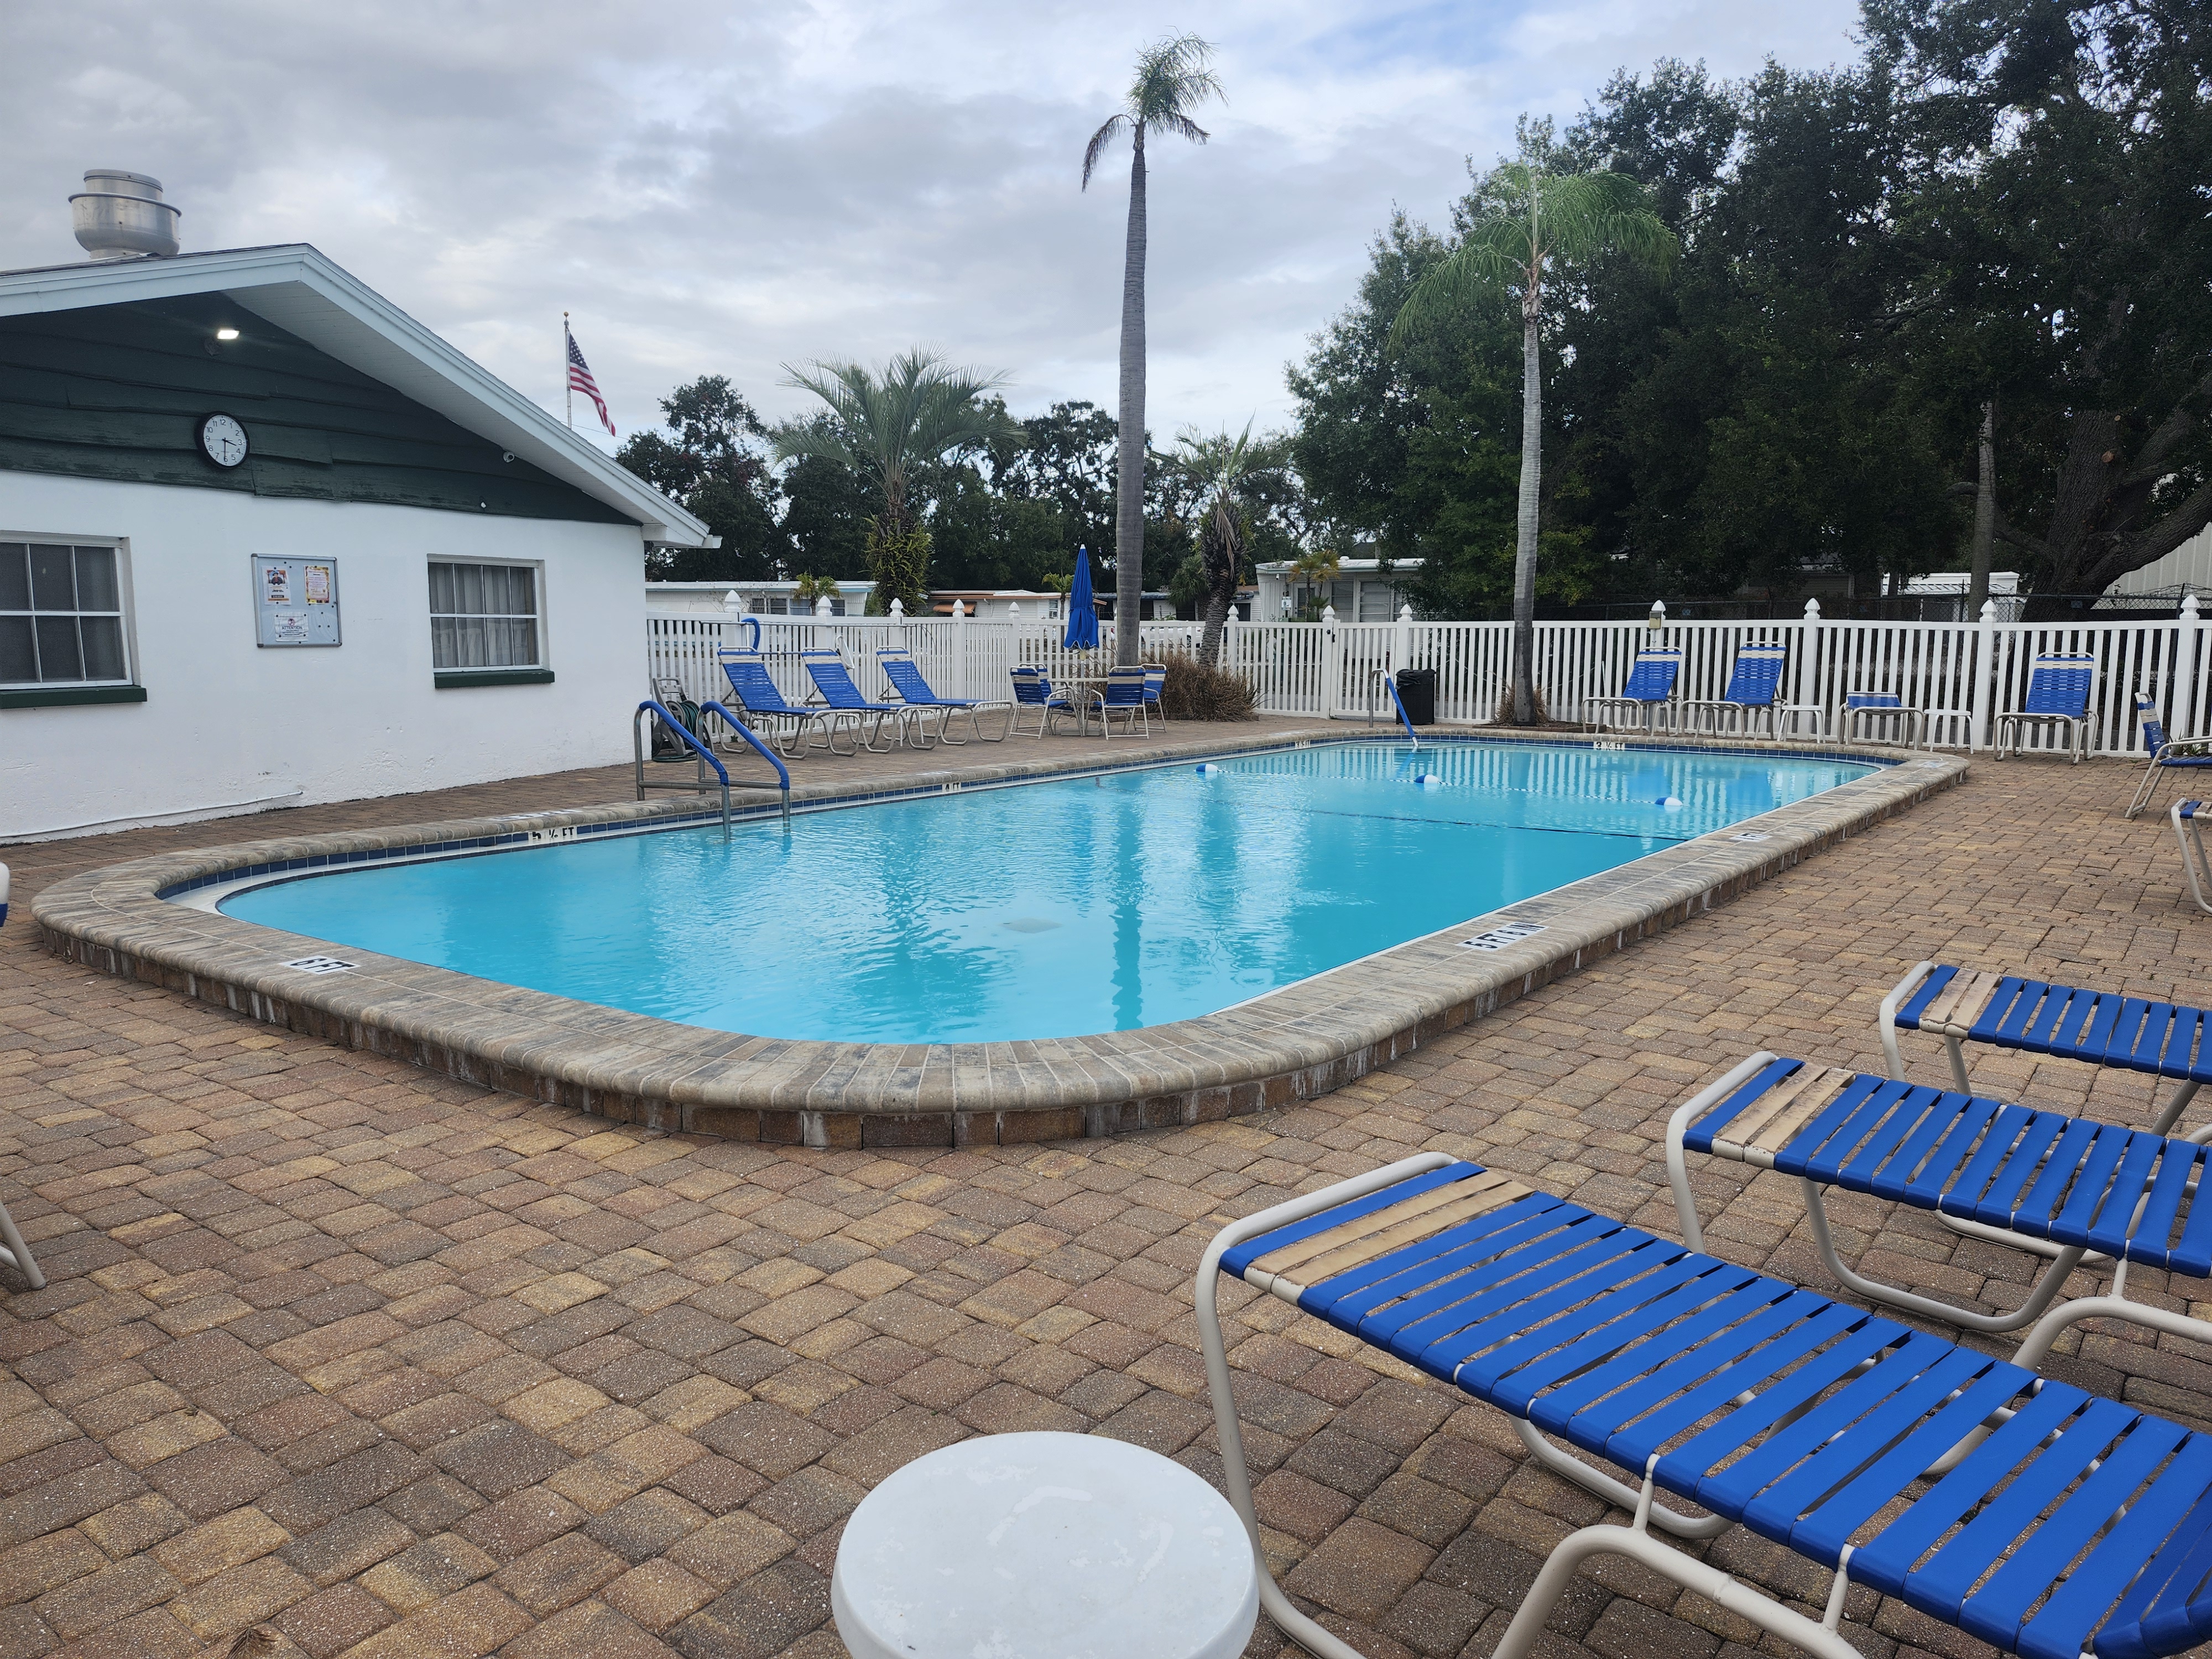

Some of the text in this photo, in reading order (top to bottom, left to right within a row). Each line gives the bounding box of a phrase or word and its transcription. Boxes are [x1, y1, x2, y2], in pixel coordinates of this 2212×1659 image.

[1506, 922, 1546, 932] IN
[1475, 933, 1517, 944] FT
[1462, 941, 1498, 949] 5
[290, 958, 357, 973] 6 FT
